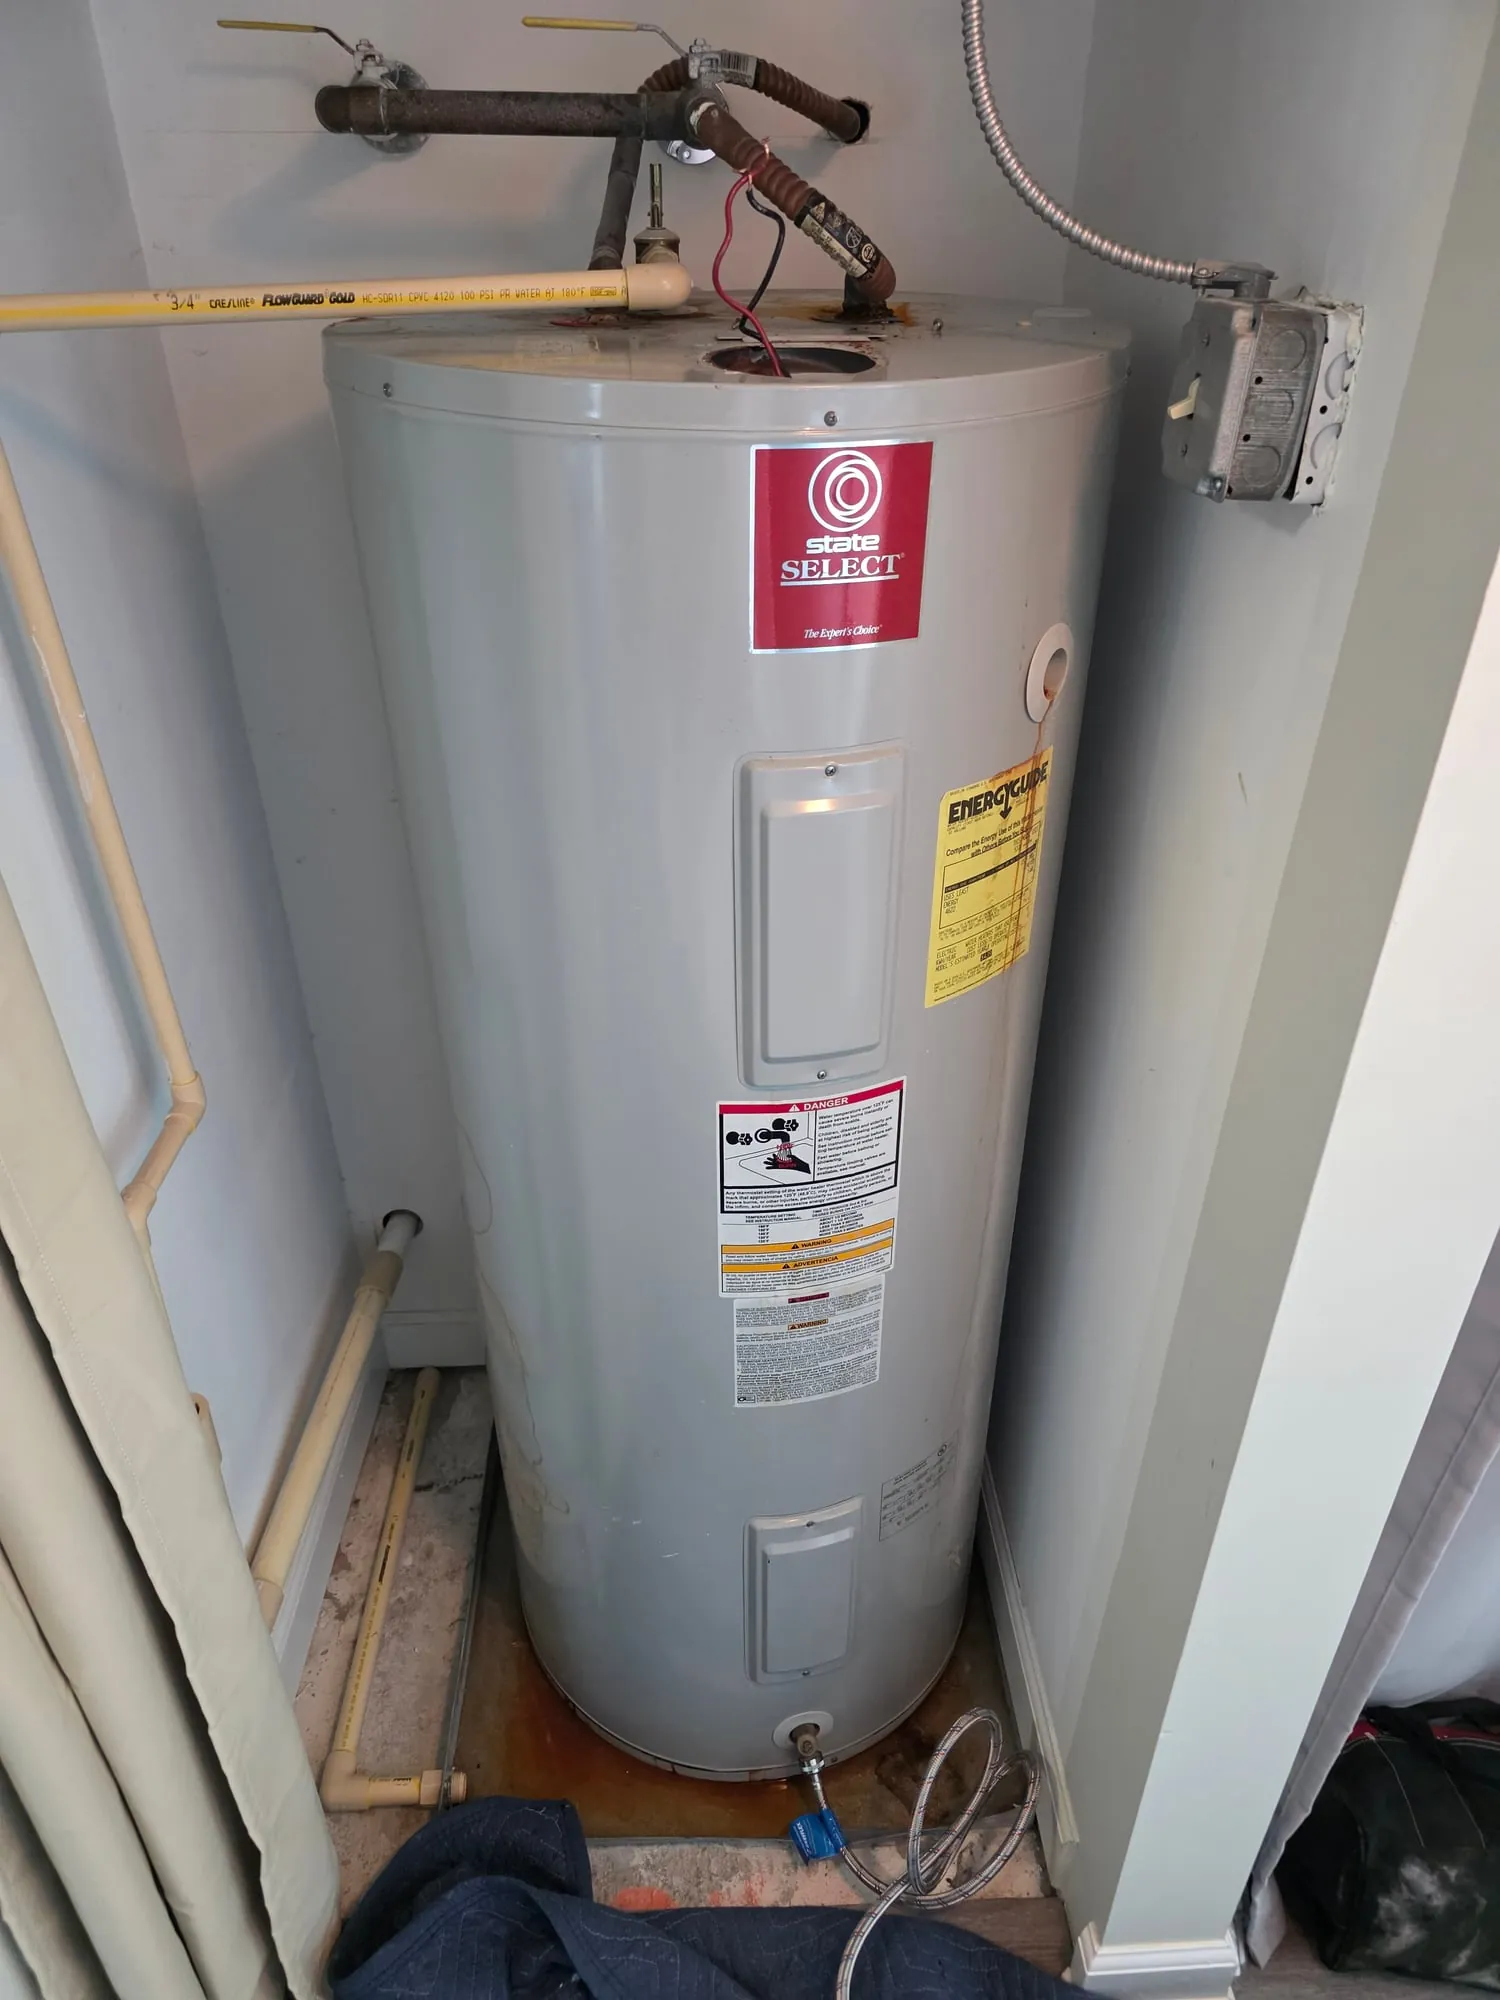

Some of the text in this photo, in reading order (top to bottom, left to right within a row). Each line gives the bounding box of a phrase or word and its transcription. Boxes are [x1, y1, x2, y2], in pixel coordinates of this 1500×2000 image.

[329, 291, 355, 304] GOLD
[362, 292, 403, 304] HC-SDR11
[408, 292, 429, 302] CPVC
[433, 290, 455, 301] 4120
[460, 290, 475, 300] 100
[479, 289, 494, 300] PSI
[500, 288, 511, 299] PR
[515, 287, 541, 299] WATER
[545, 287, 555, 298] AT
[561, 286, 585, 297] 180°F
[806, 533, 880, 554] state
[804, 629, 819, 639] The
[819, 626, 852, 639] Expert's
[948, 761, 1049, 824] ENERGYGUIDE
[946, 844, 971, 857] Compare
[971, 839, 980, 848] the
[981, 831, 997, 845] Energy
[999, 827, 1007, 835] Use
[1013, 820, 1021, 828] this
[971, 849, 981, 857] with
[981, 842, 997, 853] Others
[997, 835, 1012, 845] Before
[803, 1097, 849, 1111] DANGER
[834, 1109, 861, 1117] temperature
[801, 1239, 832, 1248] WARNING
[793, 1255, 839, 1268] ADVERTENCIA
